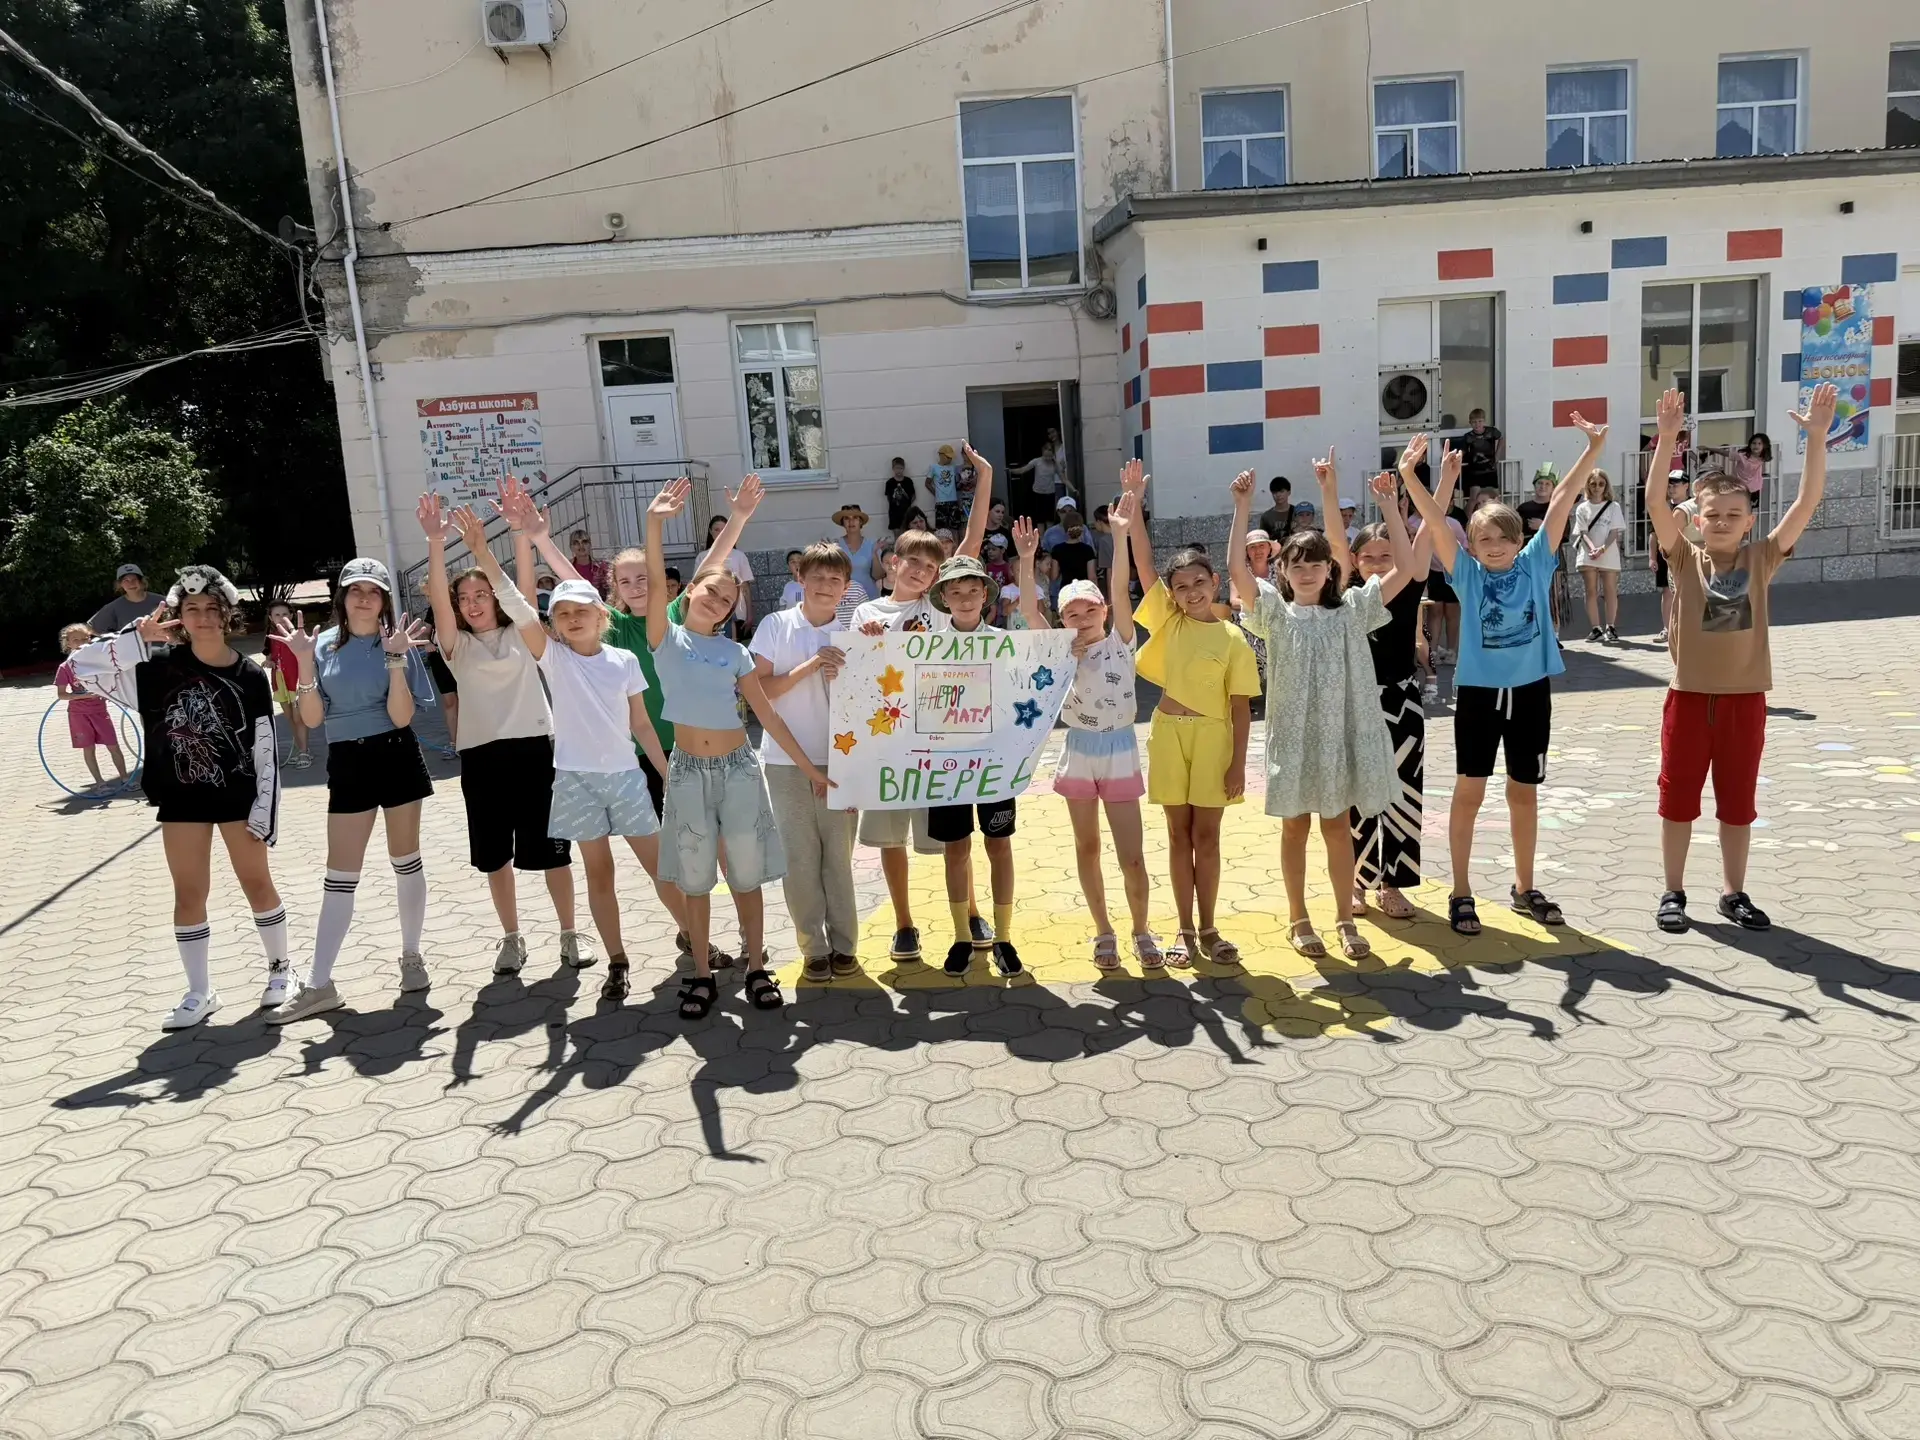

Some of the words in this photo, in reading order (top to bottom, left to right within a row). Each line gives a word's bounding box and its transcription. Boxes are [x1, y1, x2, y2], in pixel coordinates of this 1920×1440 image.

[1802, 364, 1869, 380] ЗВОНОК
[439, 400, 477, 413] Азбука
[479, 399, 516, 409] школы
[427, 419, 462, 429] Активность
[497, 413, 527, 425] Оценка
[445, 430, 472, 441] Знания
[498, 444, 533, 455] Творчество
[431, 458, 465, 468] Искусство
[512, 457, 543, 467] Ценность
[906, 634, 1016, 661] ОРЛЯТА
[921, 671, 937, 680] НАШ
